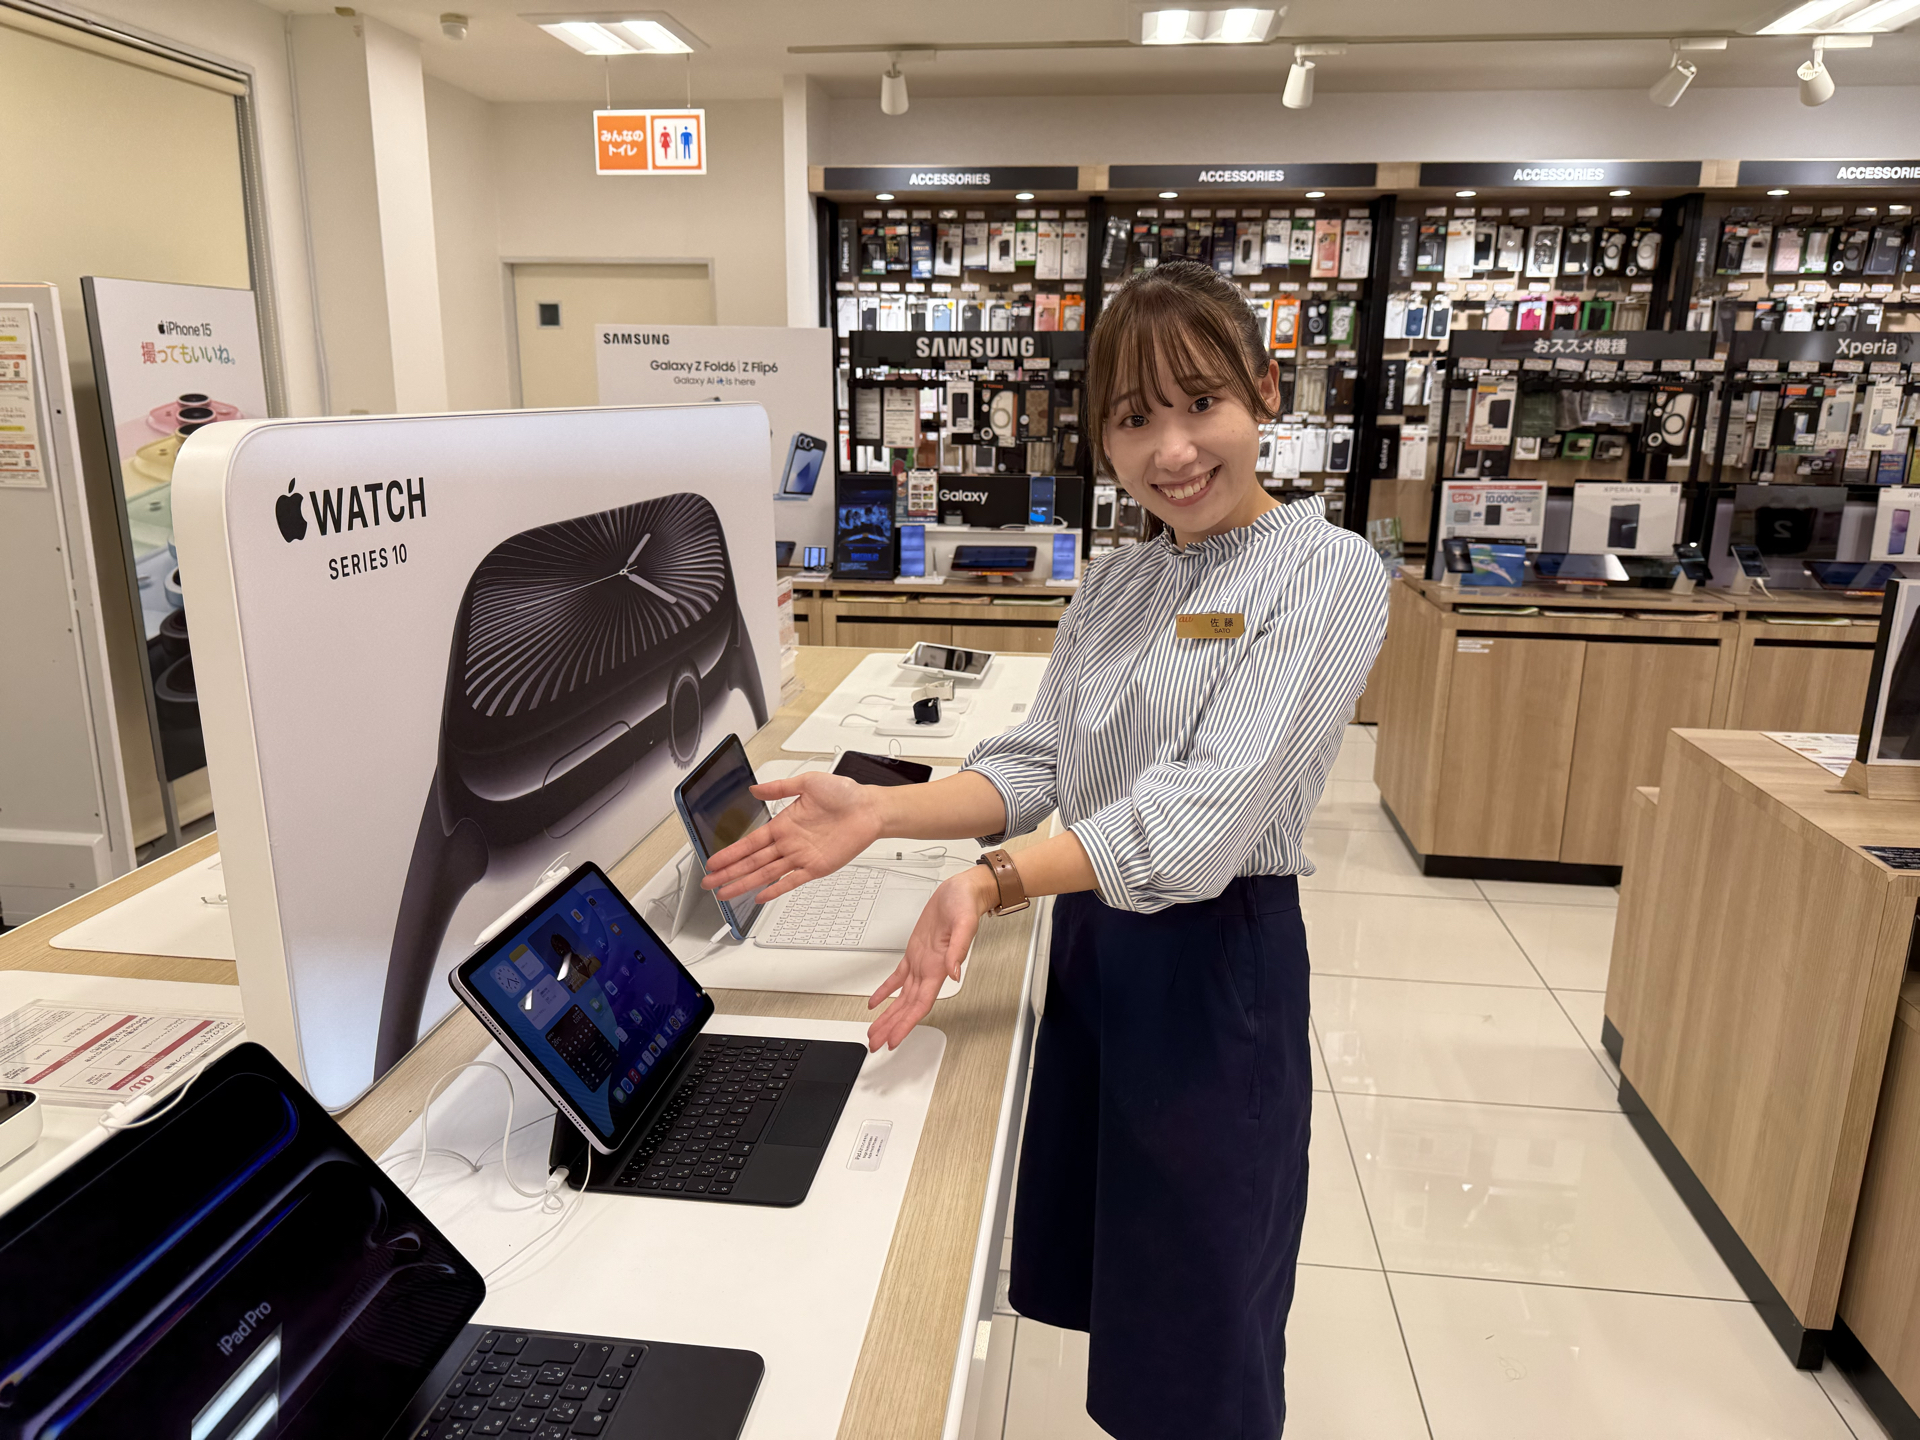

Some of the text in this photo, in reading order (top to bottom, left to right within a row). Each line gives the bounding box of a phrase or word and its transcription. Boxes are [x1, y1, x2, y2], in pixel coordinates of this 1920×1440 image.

[600, 129, 644, 142] みんなの
[608, 143, 638, 157] トイレ
[909, 173, 991, 186] ACCESSORIES
[1198, 169, 1285, 183] ACCESSORIES
[1513, 167, 1605, 181] ACCESSORIES
[165, 321, 212, 337] iPhone 15
[603, 333, 670, 346] SAMSUNG
[916, 336, 1035, 358] SAMSUNG
[1532, 337, 1628, 356] おススメ機種
[141, 341, 236, 365] 撮ってもいいね。
[1836, 338, 1898, 359] Xperia
[650, 360, 778, 376] Galaxy Z Fold6 Z Flip6
[673, 376, 704, 387] Galaxy
[734, 377, 756, 386] here
[939, 489, 988, 505] Galaxy
[309, 476, 427, 536] WATCH
[329, 543, 408, 580] SERIES 10
[1210, 618, 1234, 627] 佐藤
[216, 1301, 272, 1356] iPad Pro
